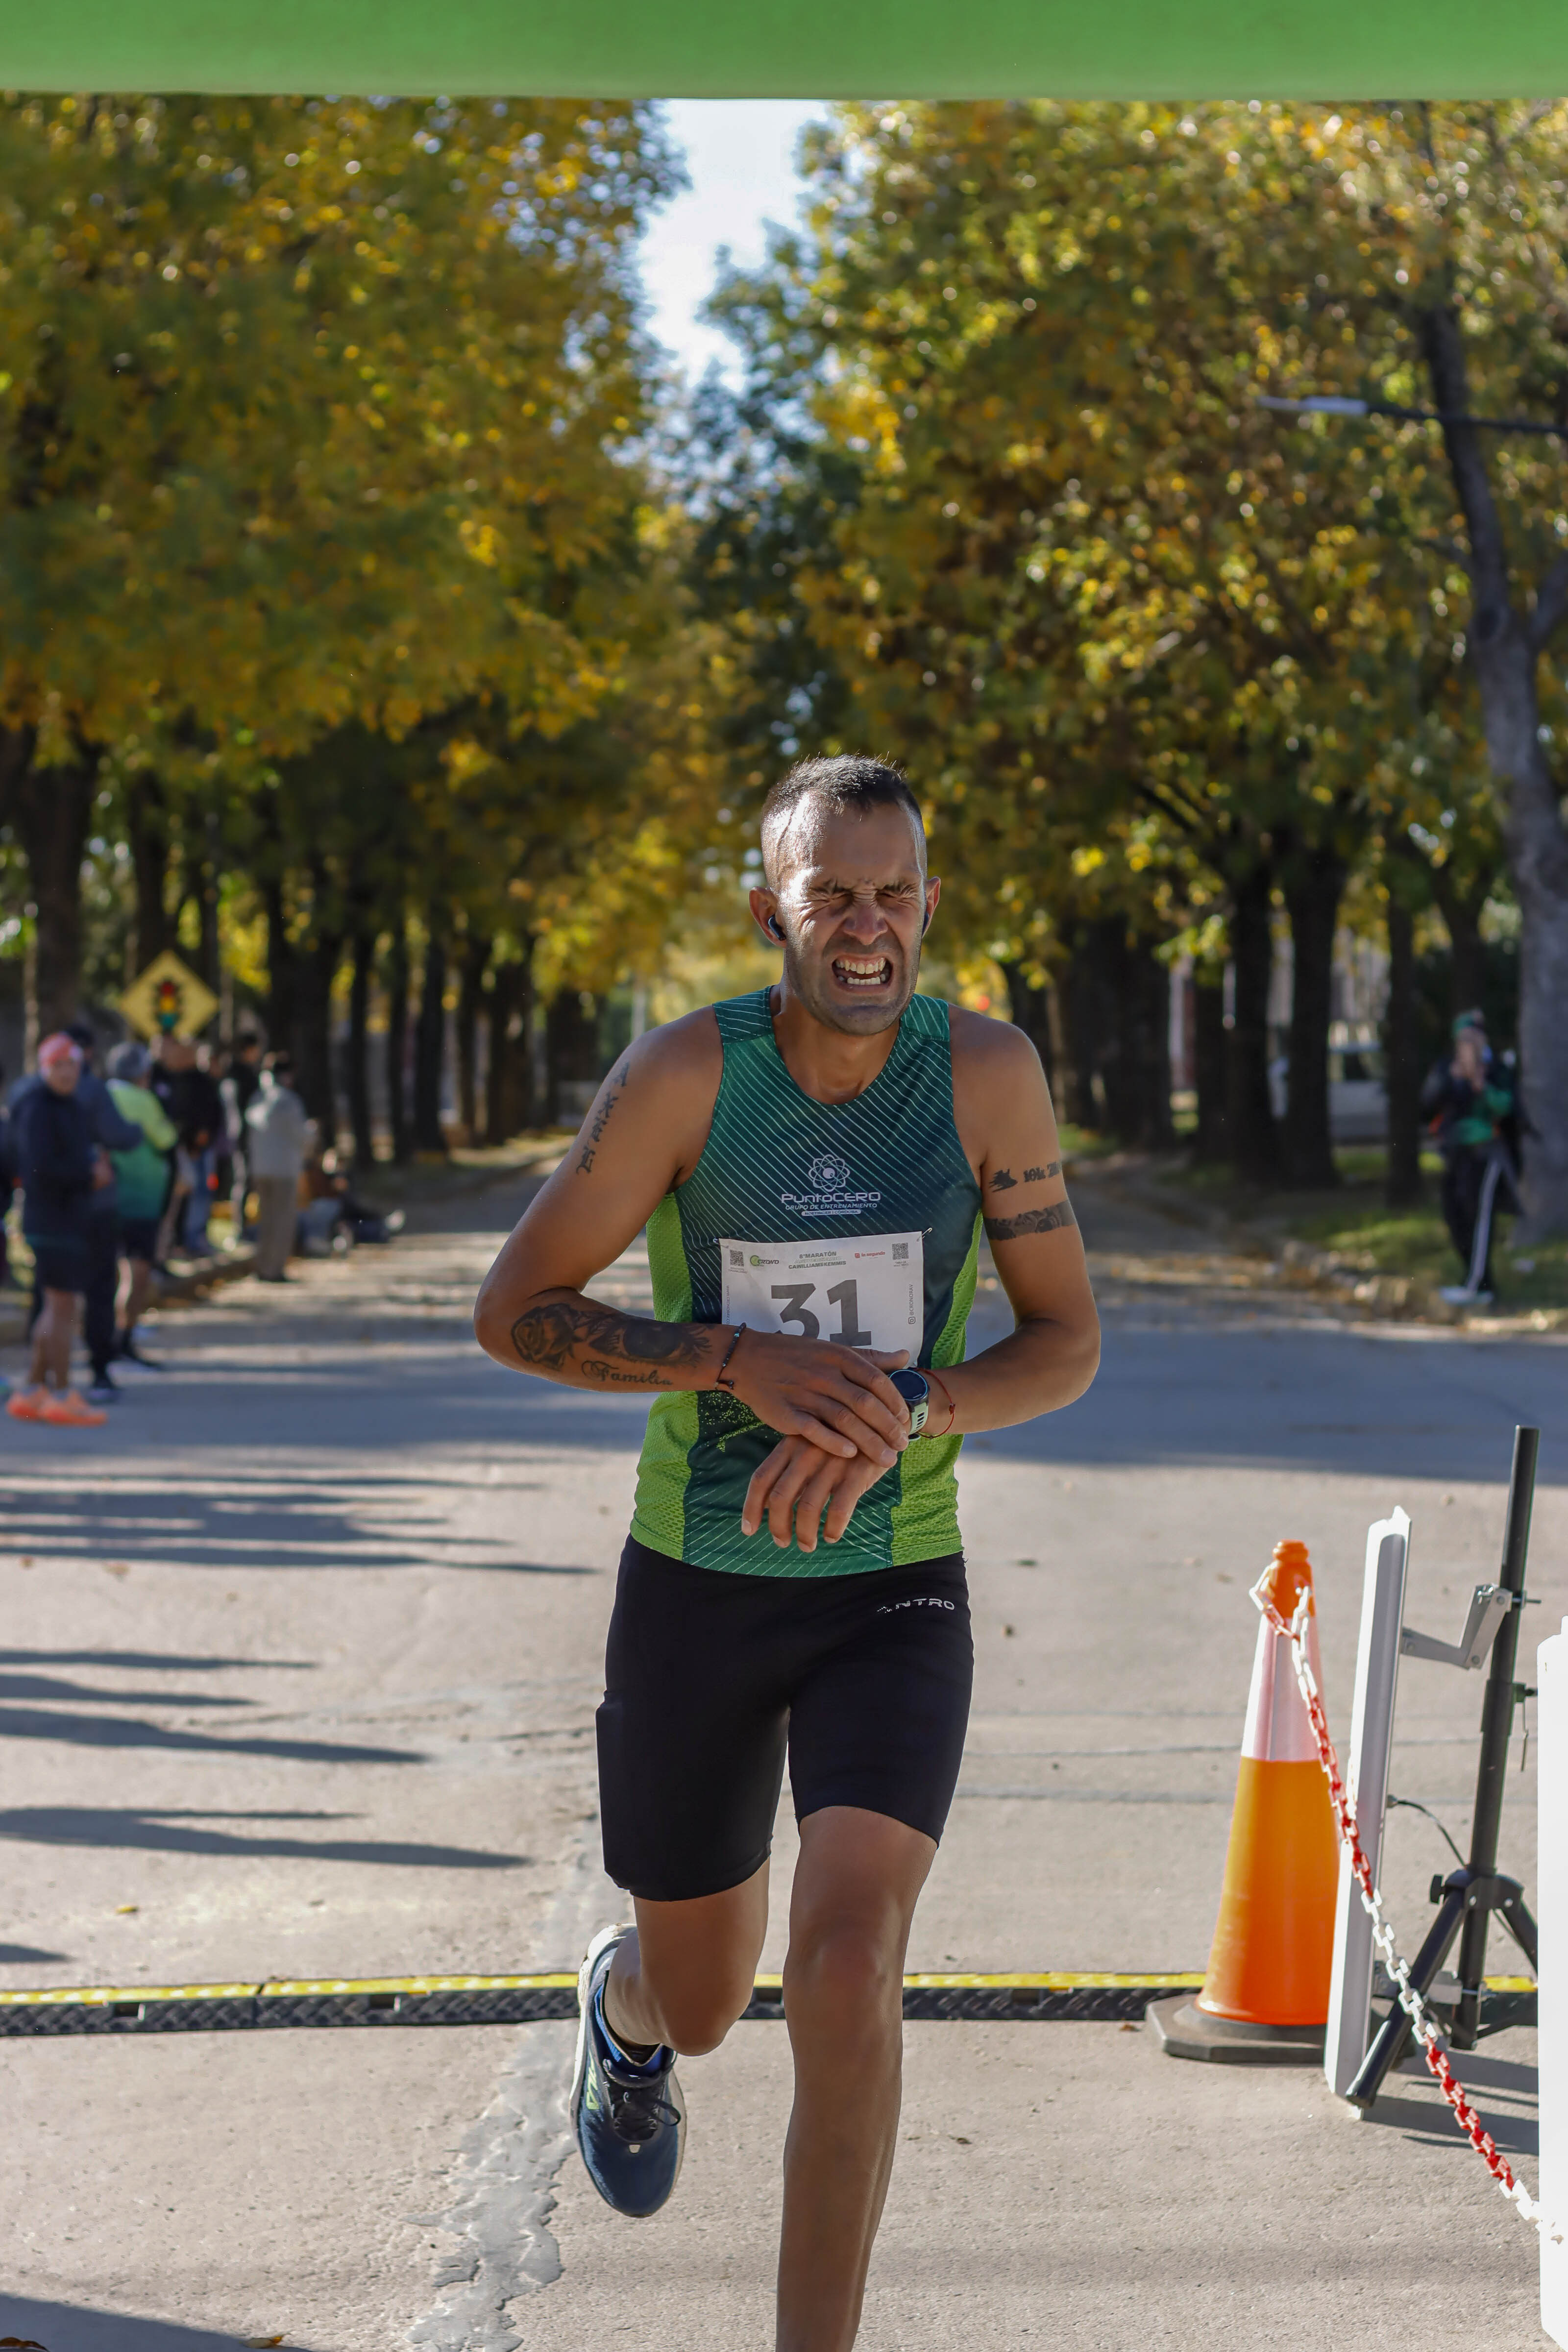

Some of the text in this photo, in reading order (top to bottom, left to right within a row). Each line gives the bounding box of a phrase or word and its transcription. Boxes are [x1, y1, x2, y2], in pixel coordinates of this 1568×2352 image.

[781, 1192, 881, 1203] PuntoCERO
[771, 1279, 872, 1347] 31
[581, 1360, 673, 1385] Familia
